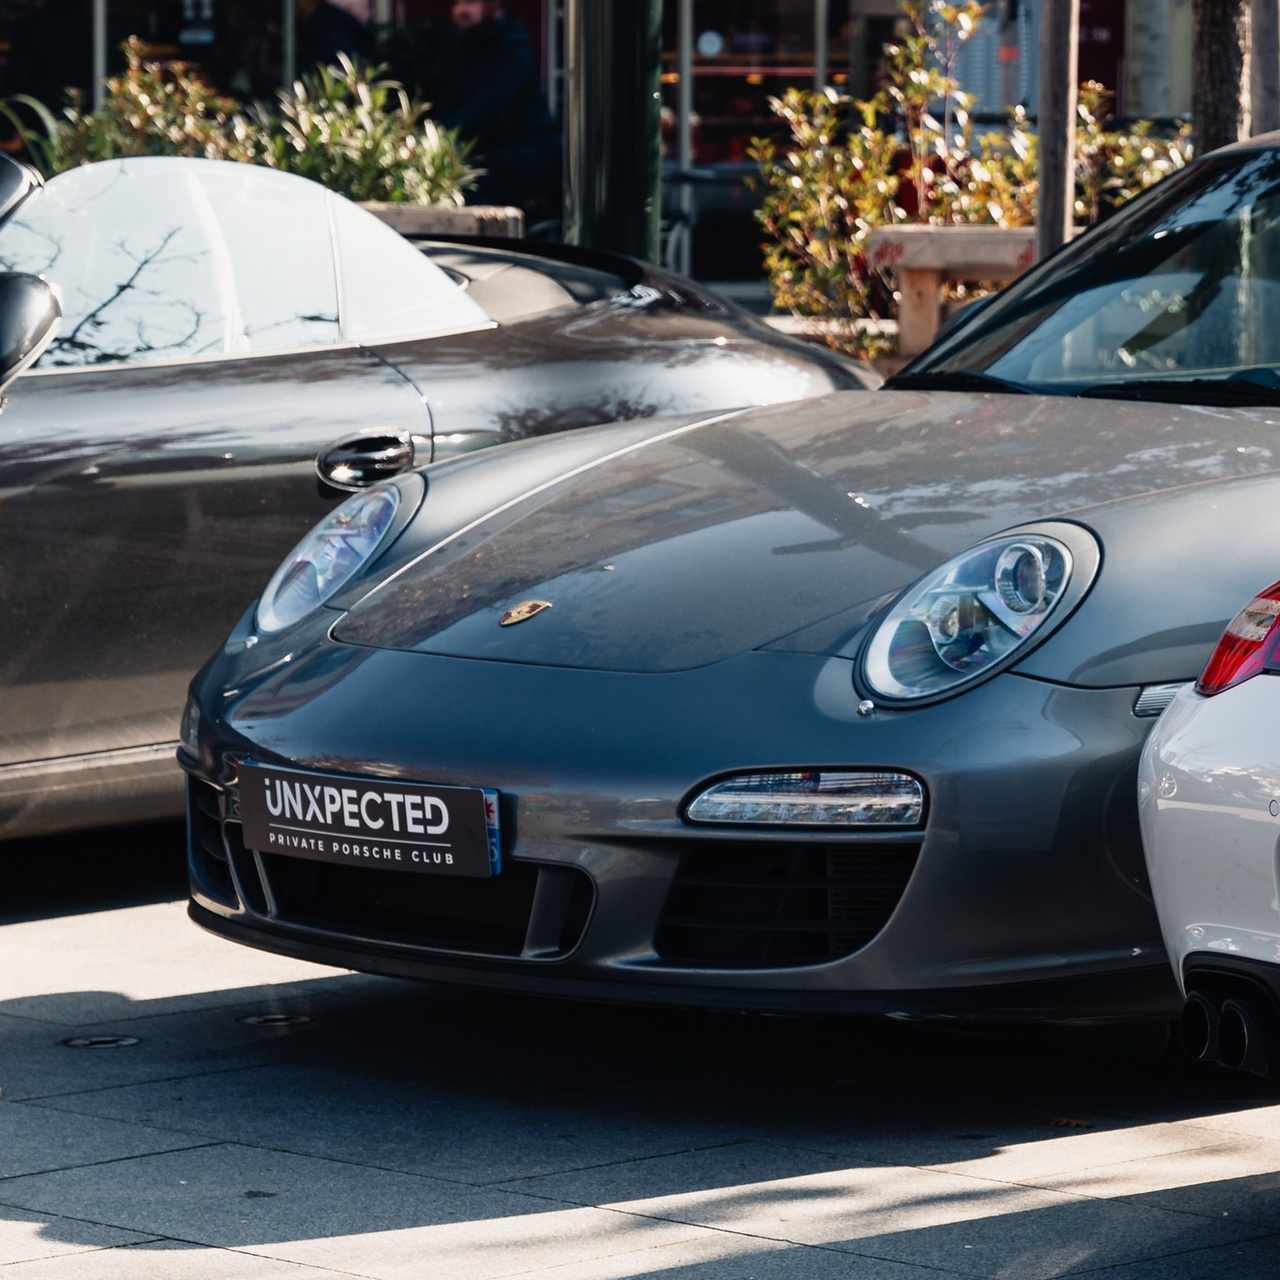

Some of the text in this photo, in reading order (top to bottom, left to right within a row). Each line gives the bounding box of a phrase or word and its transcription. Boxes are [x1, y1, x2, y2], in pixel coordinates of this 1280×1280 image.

[269, 832, 455, 866] PRIVATE PORSCHE CLUB
